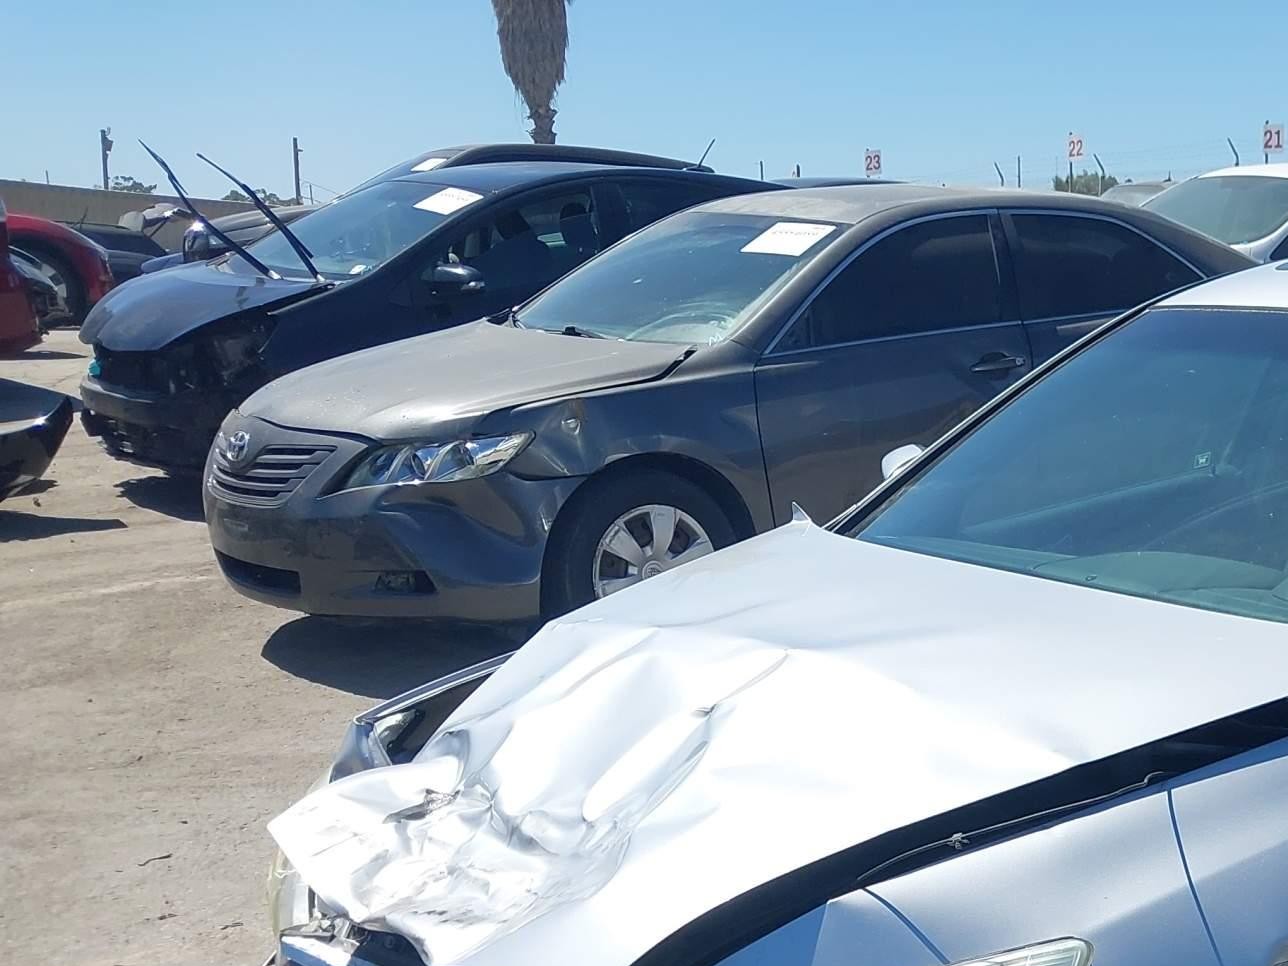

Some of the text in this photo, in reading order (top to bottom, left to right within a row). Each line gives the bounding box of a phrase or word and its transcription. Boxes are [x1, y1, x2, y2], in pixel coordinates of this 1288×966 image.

[1068, 139, 1084, 157] 22
[1263, 130, 1283, 149] 21
[865, 154, 881, 172] 23
